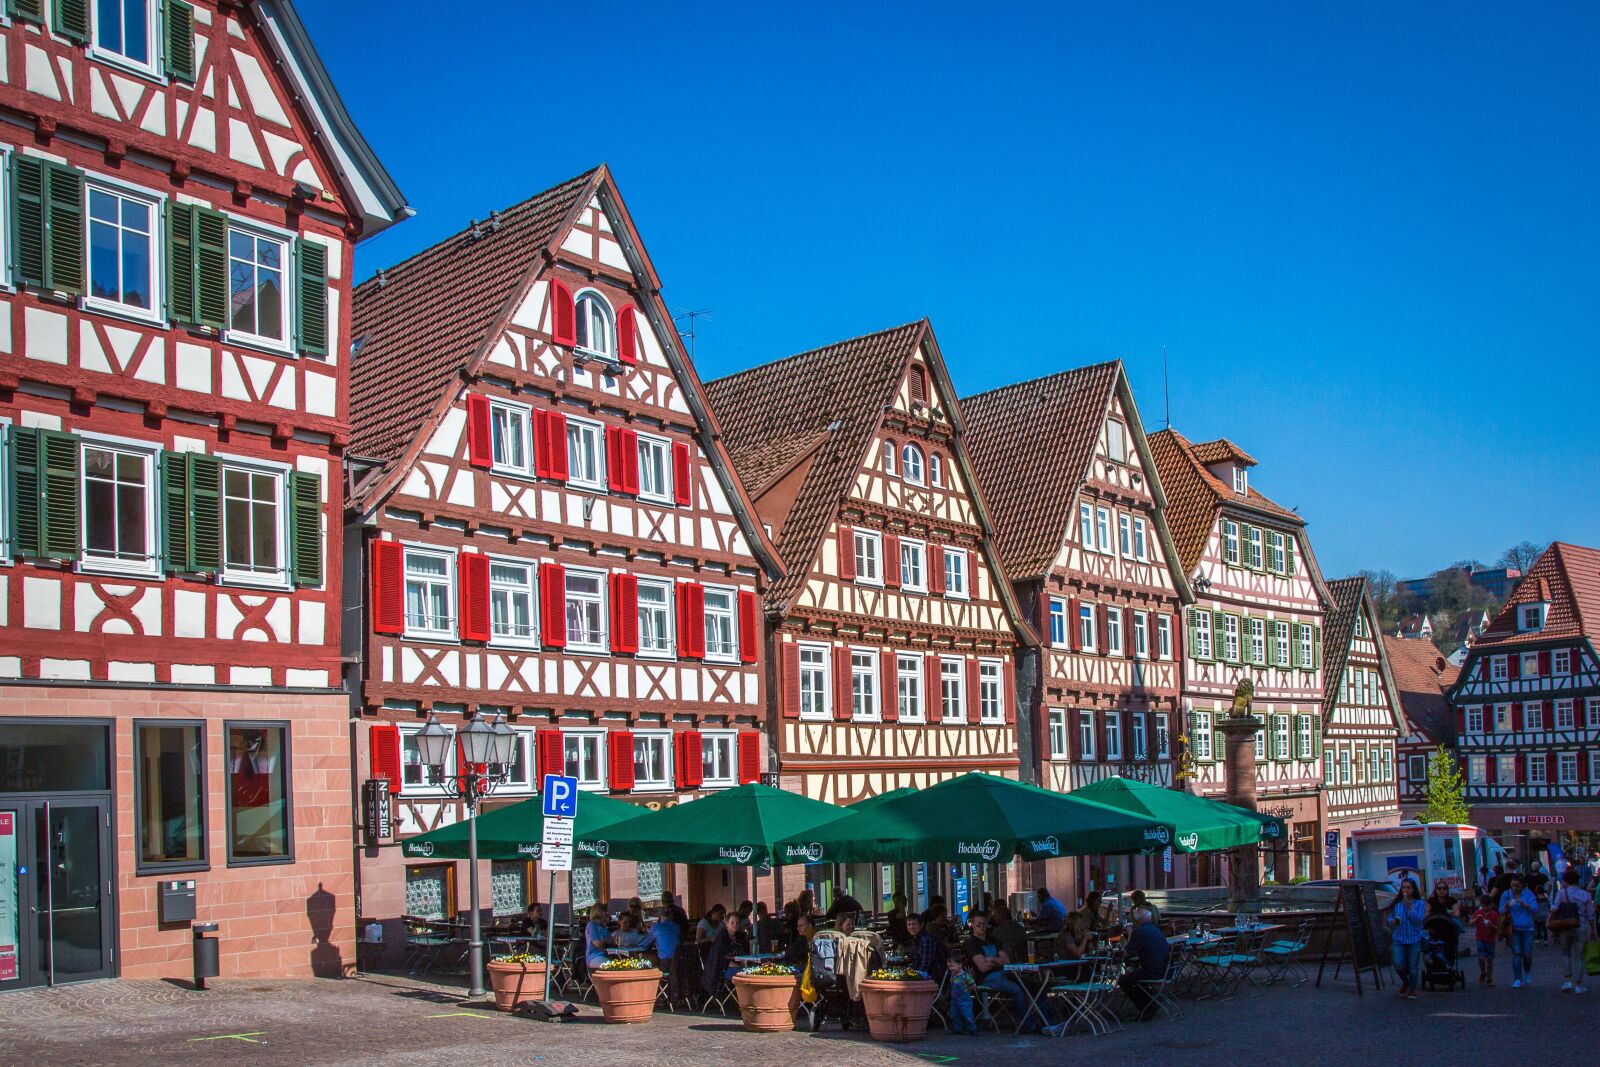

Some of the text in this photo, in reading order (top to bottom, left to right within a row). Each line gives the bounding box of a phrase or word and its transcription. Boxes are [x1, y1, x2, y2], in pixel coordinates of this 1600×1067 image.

[552, 781, 570, 811] P
[368, 782, 376, 837] ZIMMER
[379, 781, 389, 837] ZIMMER
[1504, 815, 1526, 824] WITT
[1328, 833, 1336, 845] P
[719, 847, 749, 859] Hochdorfer
[787, 845, 820, 857] Hochdorfer
[958, 841, 996, 855] Hochdorfer
